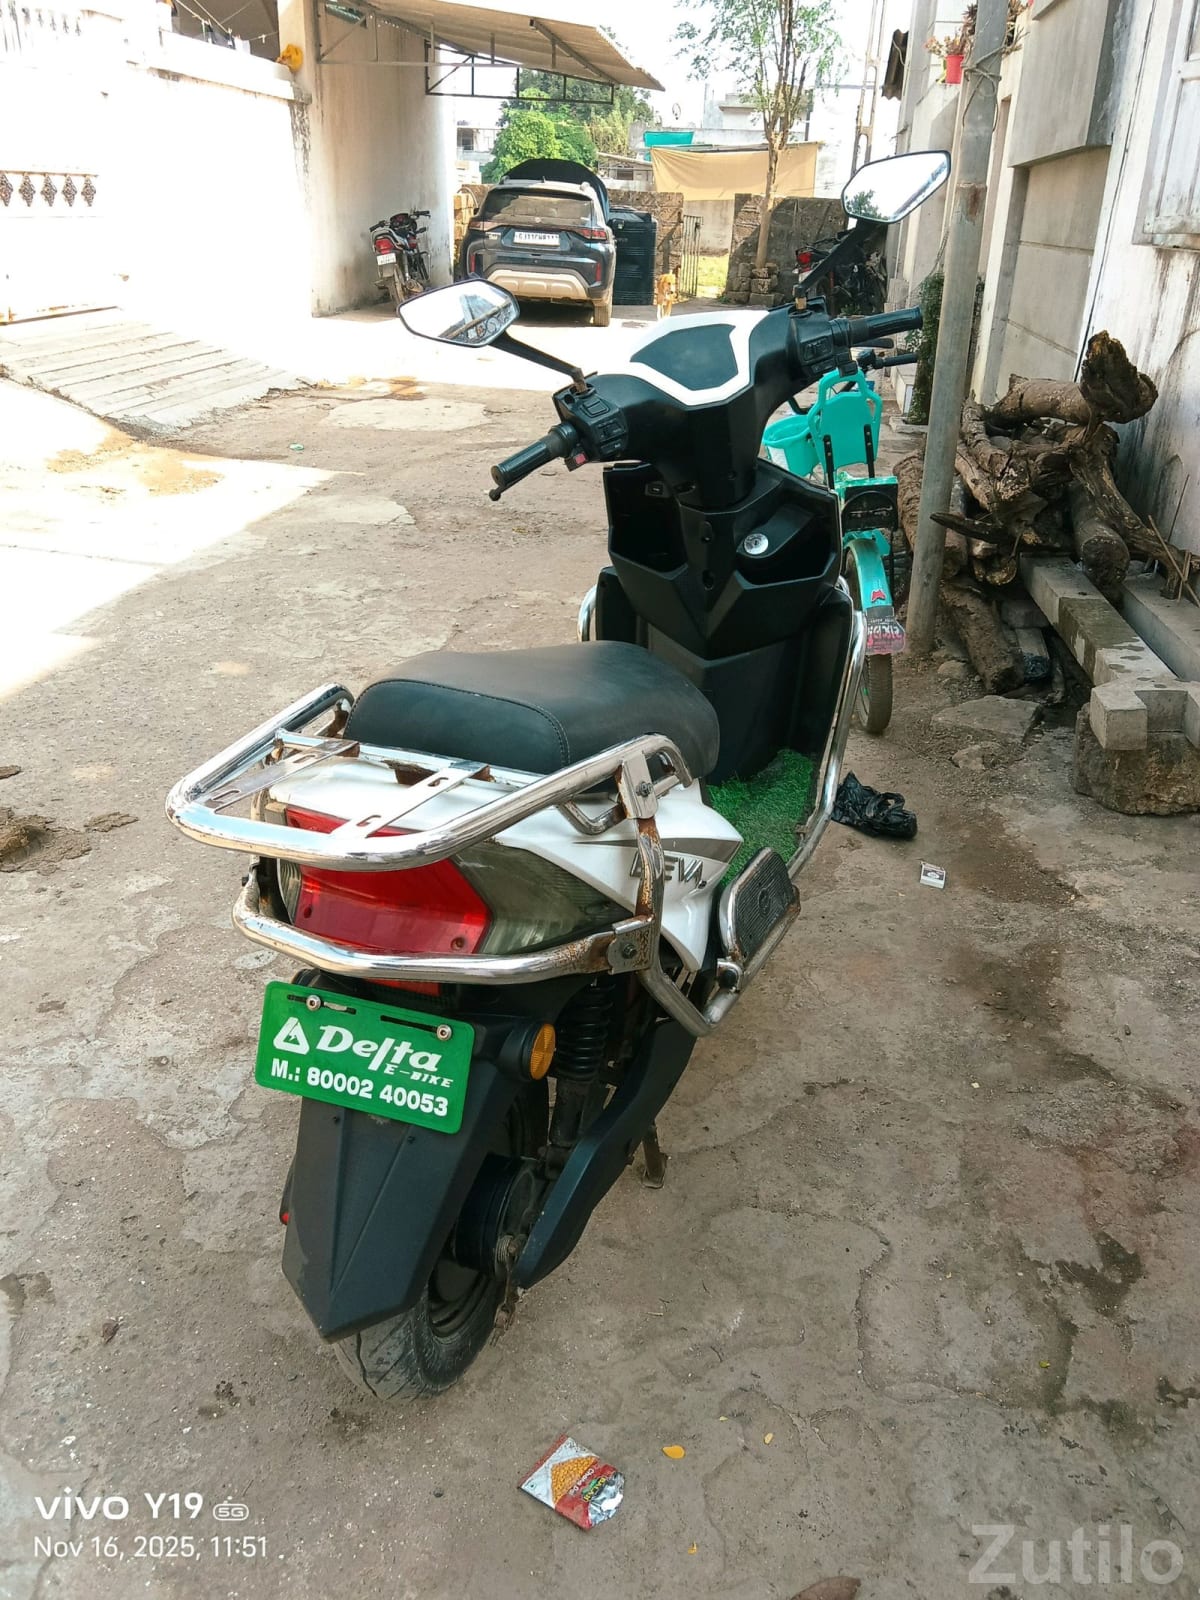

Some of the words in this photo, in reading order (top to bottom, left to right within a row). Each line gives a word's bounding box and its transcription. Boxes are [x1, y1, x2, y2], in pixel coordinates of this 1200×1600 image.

[316, 1025, 442, 1072] Delta
[271, 1058, 300, 1082] M.:
[306, 1067, 374, 1099] 80002
[379, 1084, 449, 1117] 40053
[384, 1063, 454, 1088] E-BIKE
